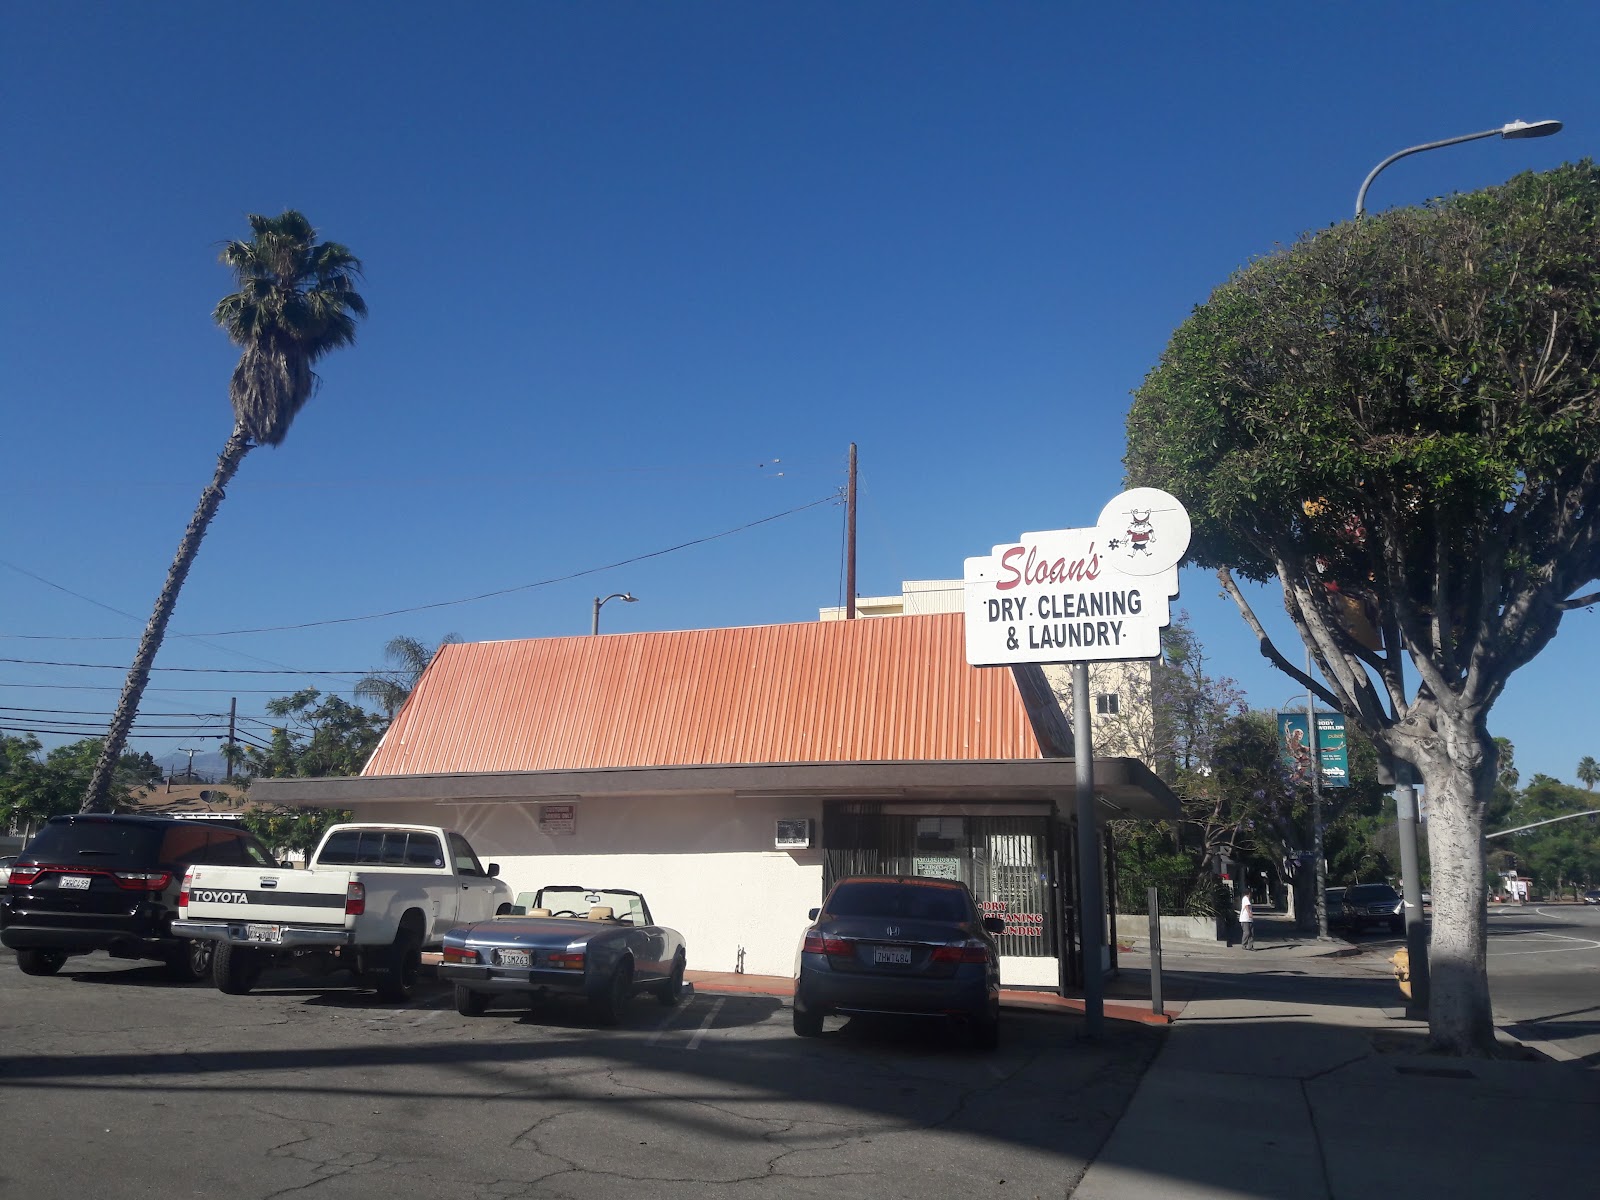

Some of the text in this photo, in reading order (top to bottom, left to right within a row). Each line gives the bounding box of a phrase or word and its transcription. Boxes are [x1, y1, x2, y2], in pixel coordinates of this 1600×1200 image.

[996, 542, 1101, 590] Sloan's
[988, 589, 1142, 622] DRY CLEANING
[1006, 620, 1123, 650] & LAUNDRY
[194, 891, 248, 904] TOYOTA
[983, 901, 1007, 911] DRY
